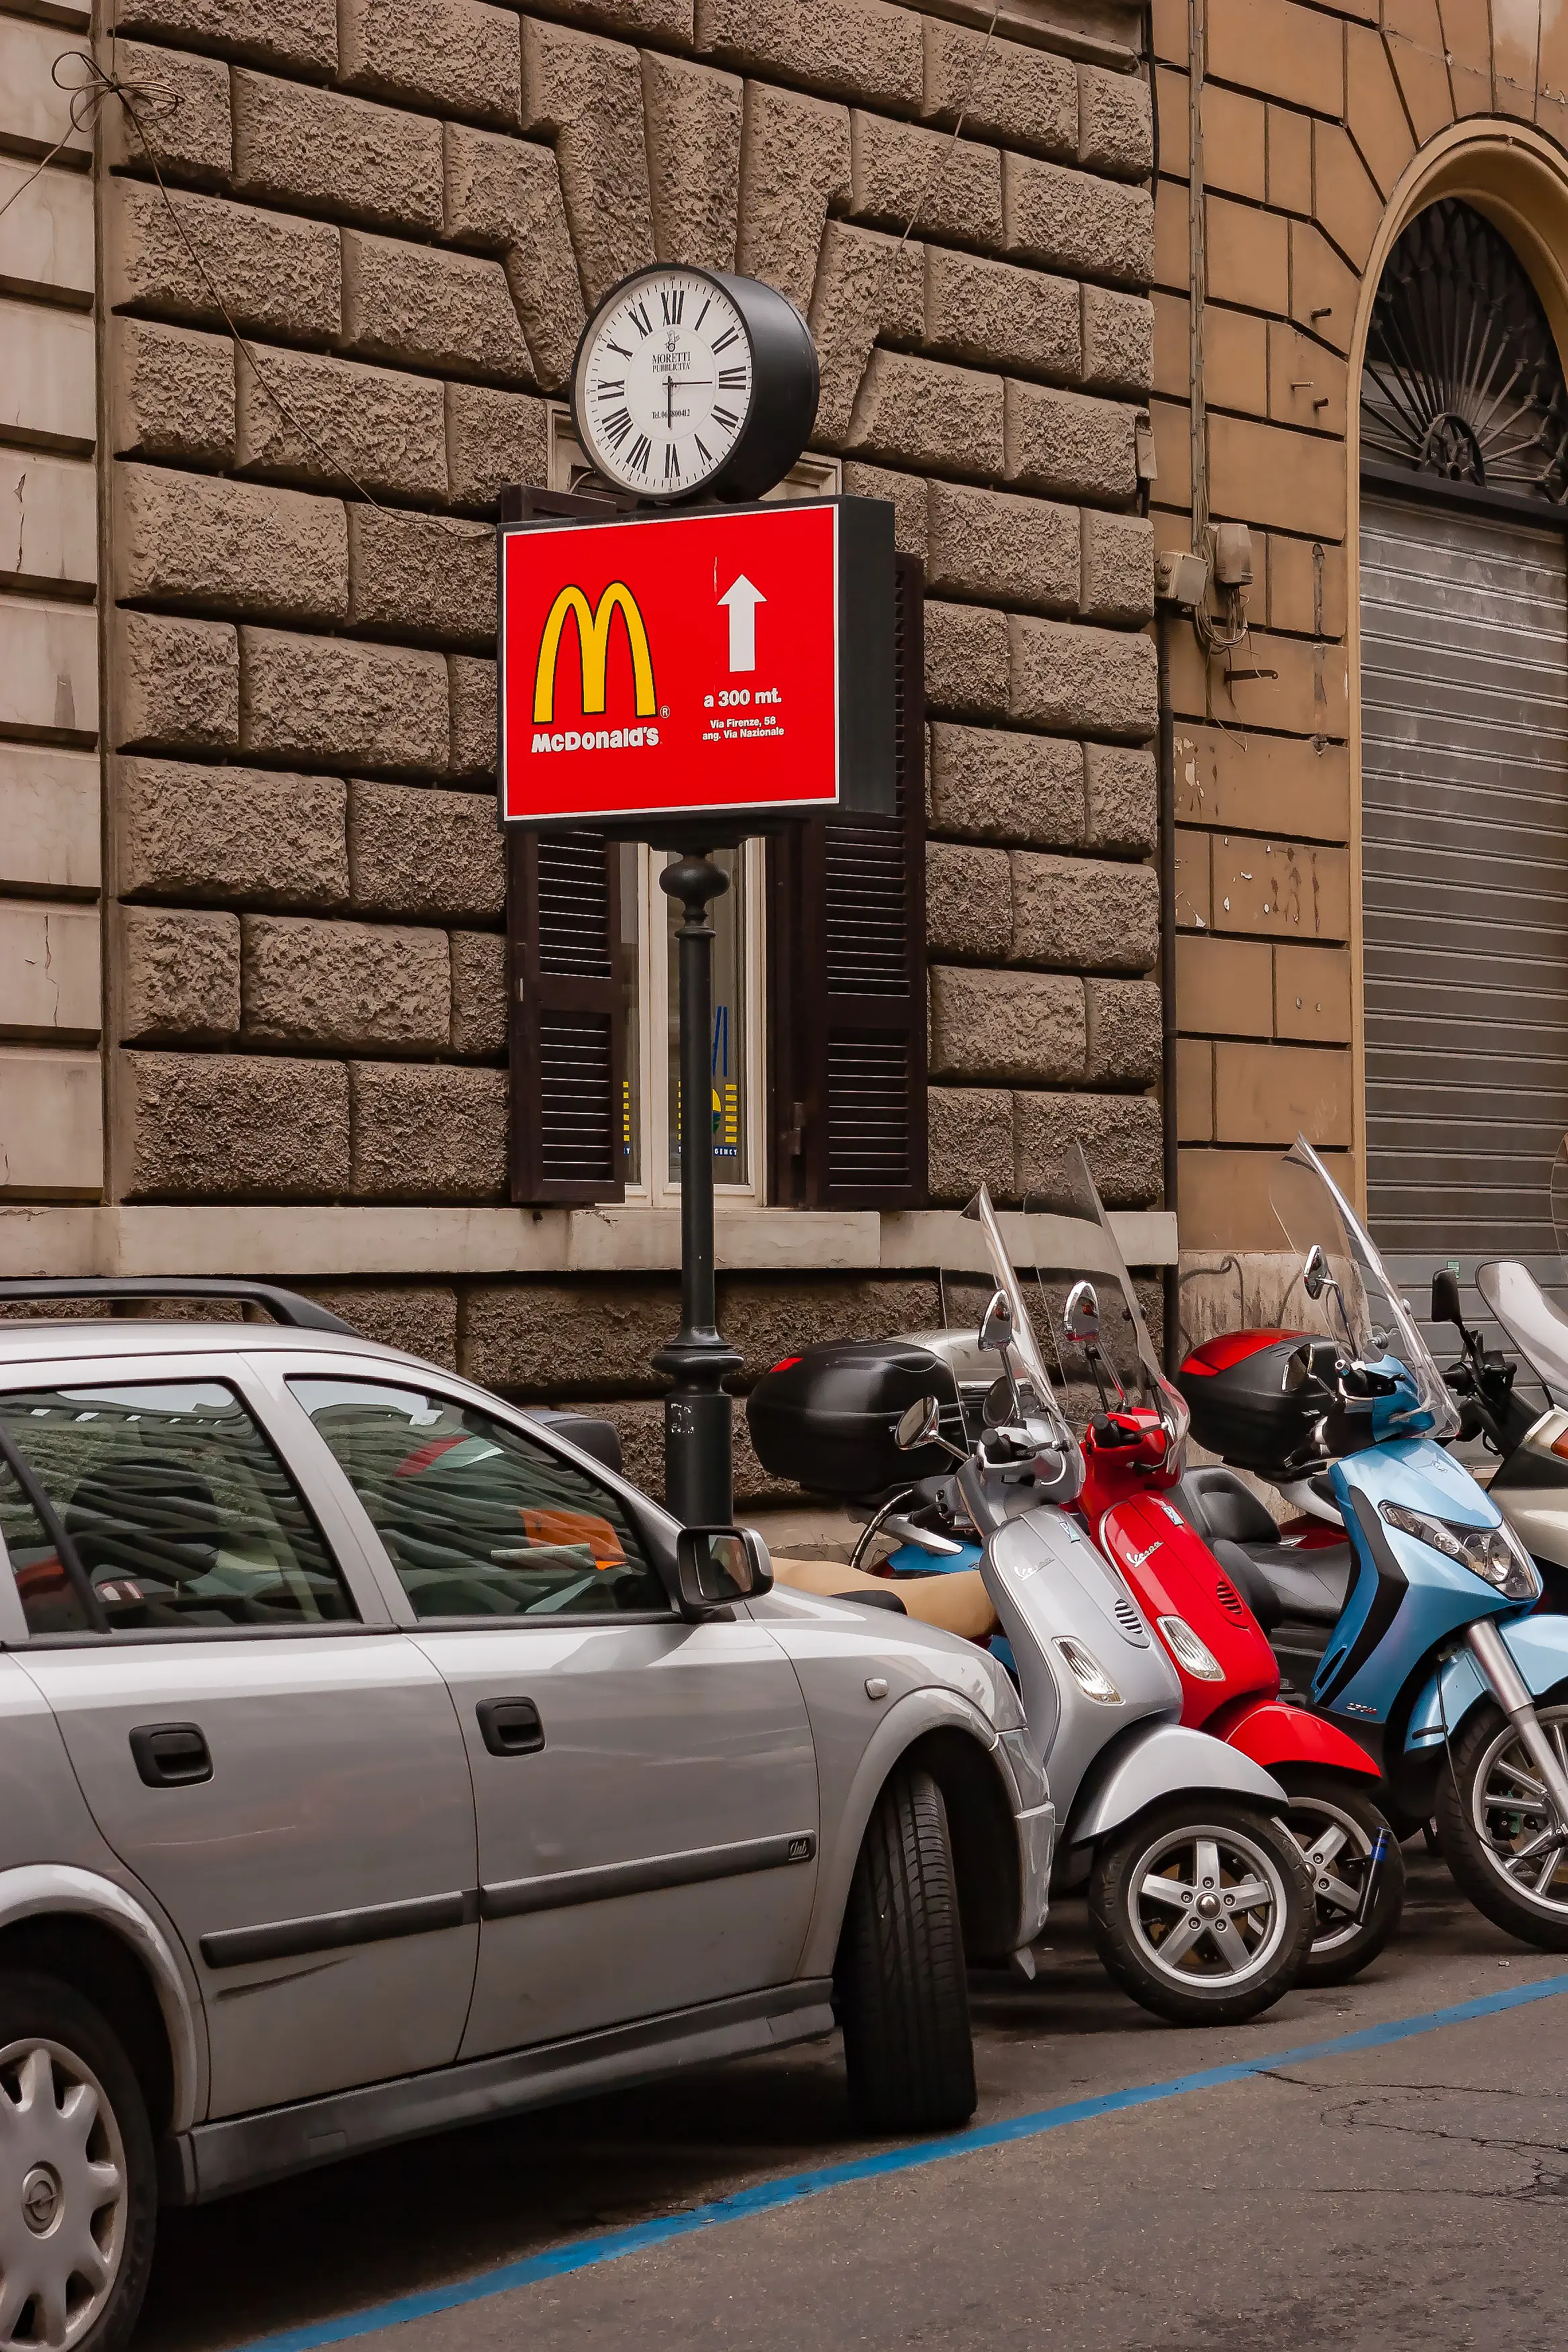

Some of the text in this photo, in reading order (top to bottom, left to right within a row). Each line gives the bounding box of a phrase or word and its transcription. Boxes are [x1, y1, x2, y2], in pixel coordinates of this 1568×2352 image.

[628, 301, 654, 340] XI
[660, 289, 685, 328] XII
[606, 338, 634, 362] X
[710, 326, 740, 356] II
[652, 351, 691, 365] MORETTI
[597, 379, 626, 401] IX
[718, 365, 747, 390] III
[601, 406, 634, 450] VIII
[625, 433, 653, 475] VII
[664, 443, 681, 479] VI
[693, 433, 714, 467] V
[703, 687, 782, 707] a 300 mt.
[702, 726, 785, 742] ang. Via Nazionale
[709, 719, 725, 729] Via
[726, 718, 762, 728] Firenze,
[531, 726, 660, 753] McDonald's
[1126, 1540, 1164, 1568] Vespa
[1013, 1557, 1056, 1582] Vespa
